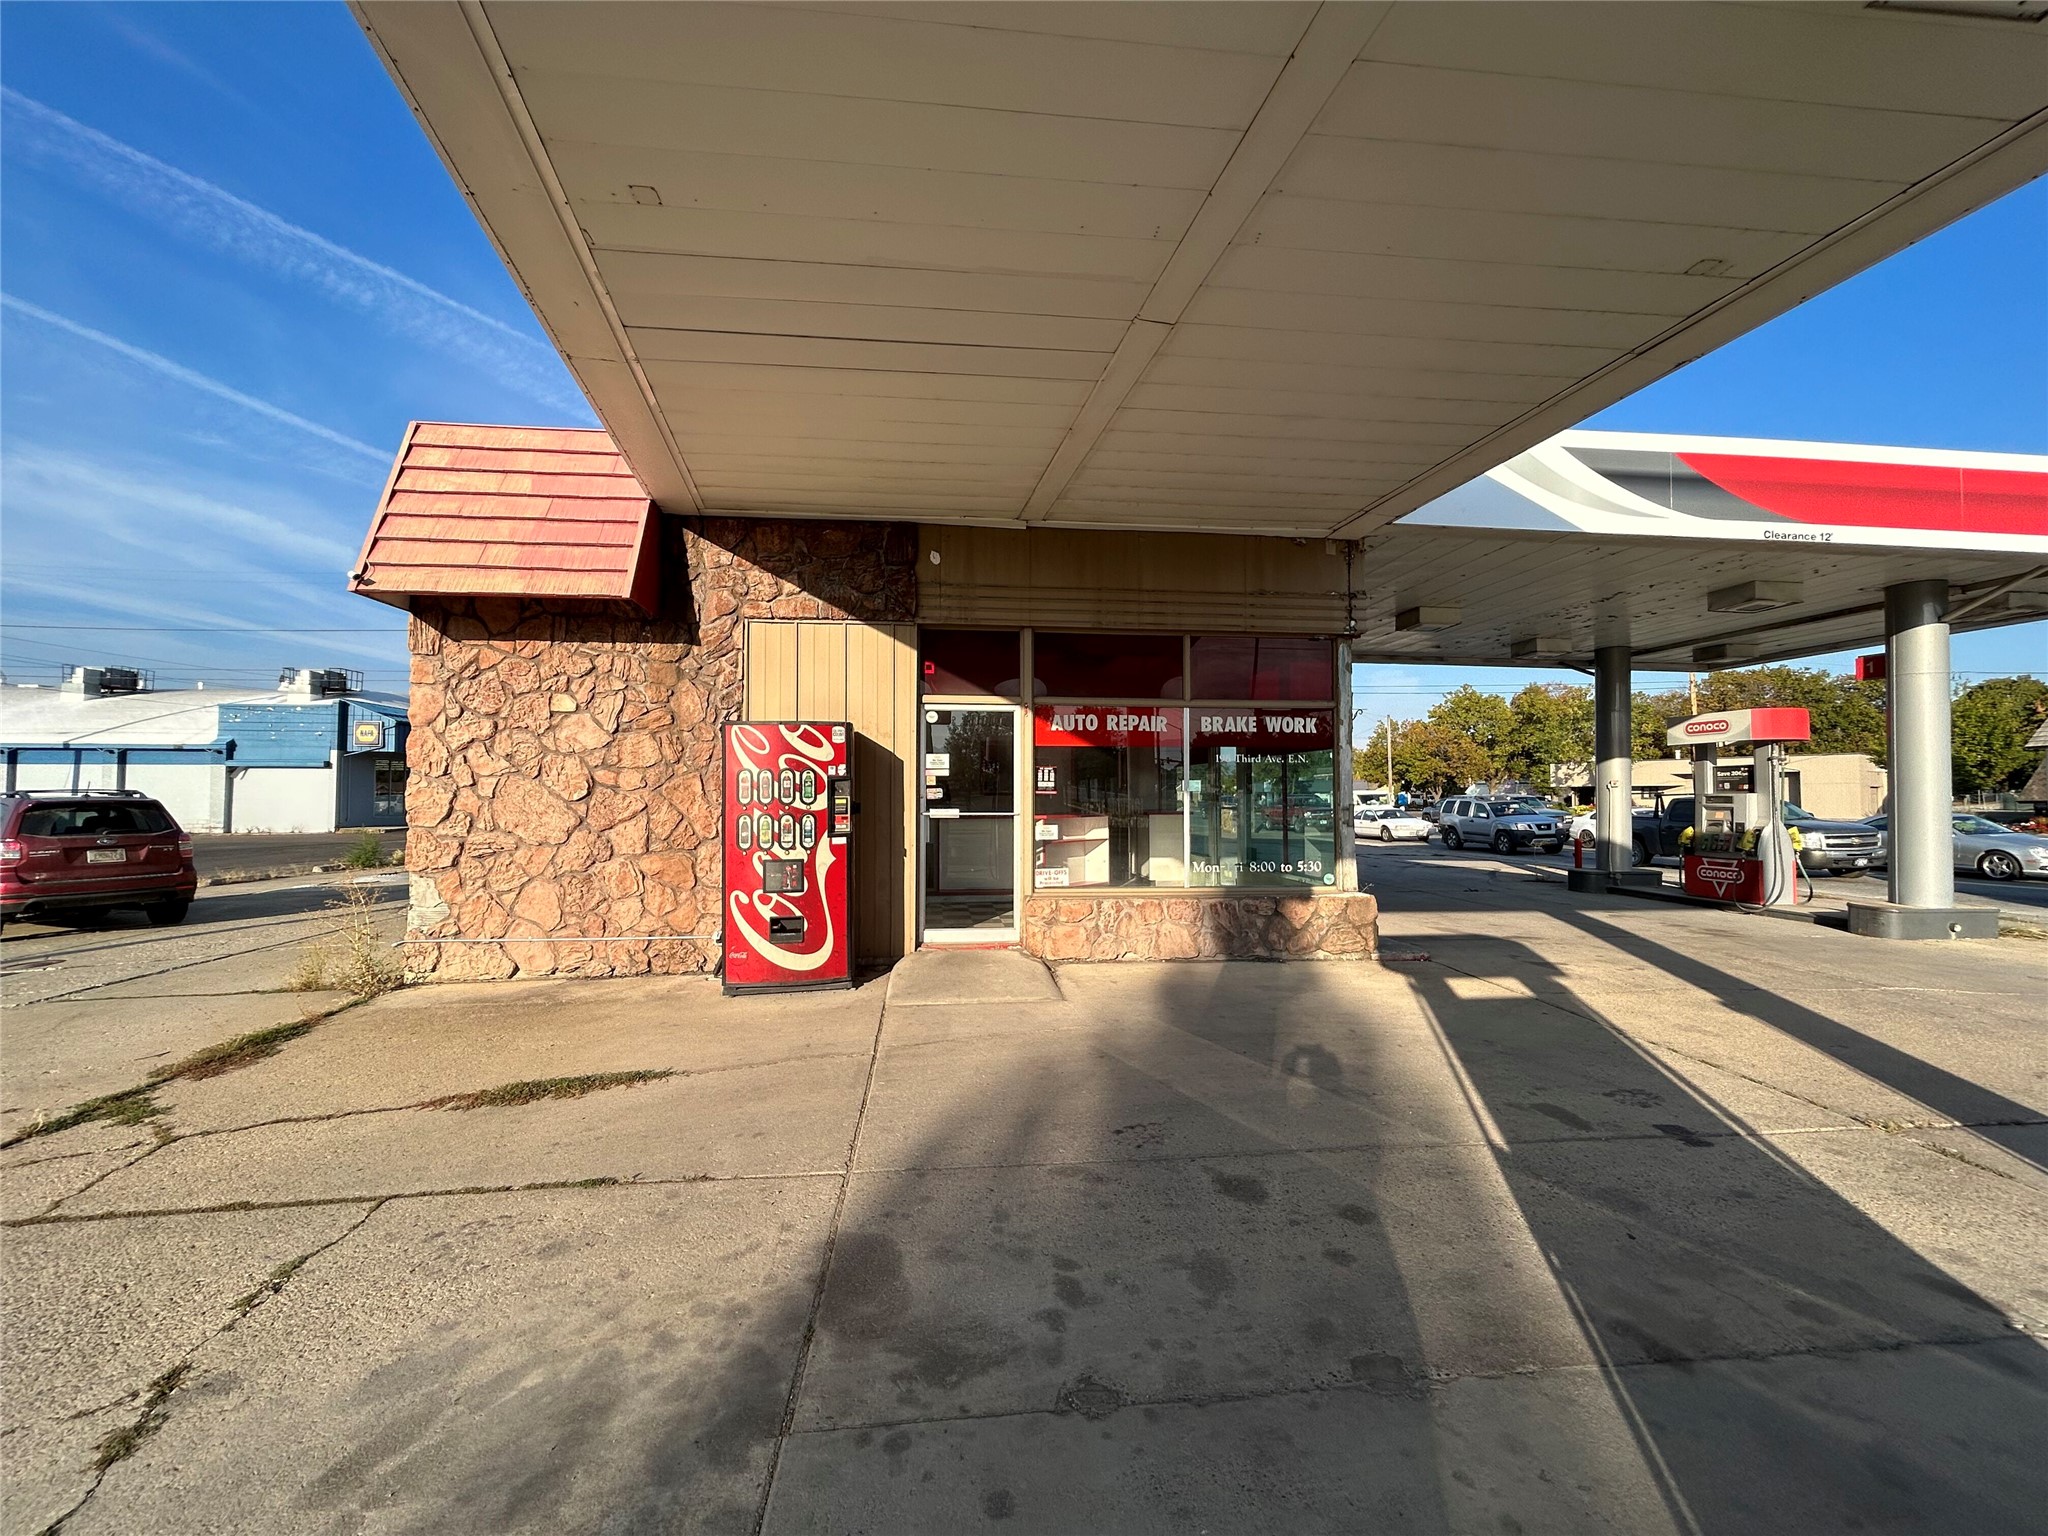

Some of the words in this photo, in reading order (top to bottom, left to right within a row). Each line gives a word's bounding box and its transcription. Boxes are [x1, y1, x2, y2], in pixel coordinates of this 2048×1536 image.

[1763, 530, 1816, 541] Clearance
[1866, 660, 1873, 673] 1
[1051, 714, 1098, 731] AUTO
[1106, 714, 1168, 732] REPAIR
[1201, 716, 1257, 733] BRAKE
[1265, 716, 1318, 734] WORK
[1236, 753, 1261, 763] Third
[1265, 754, 1285, 763] Ave.
[1288, 754, 1309, 763] E.N.
[1192, 861, 1243, 873] Mon-ri
[1249, 861, 1276, 873] 8:00
[1280, 862, 1293, 873] to
[1297, 860, 1322, 873] 5:30
